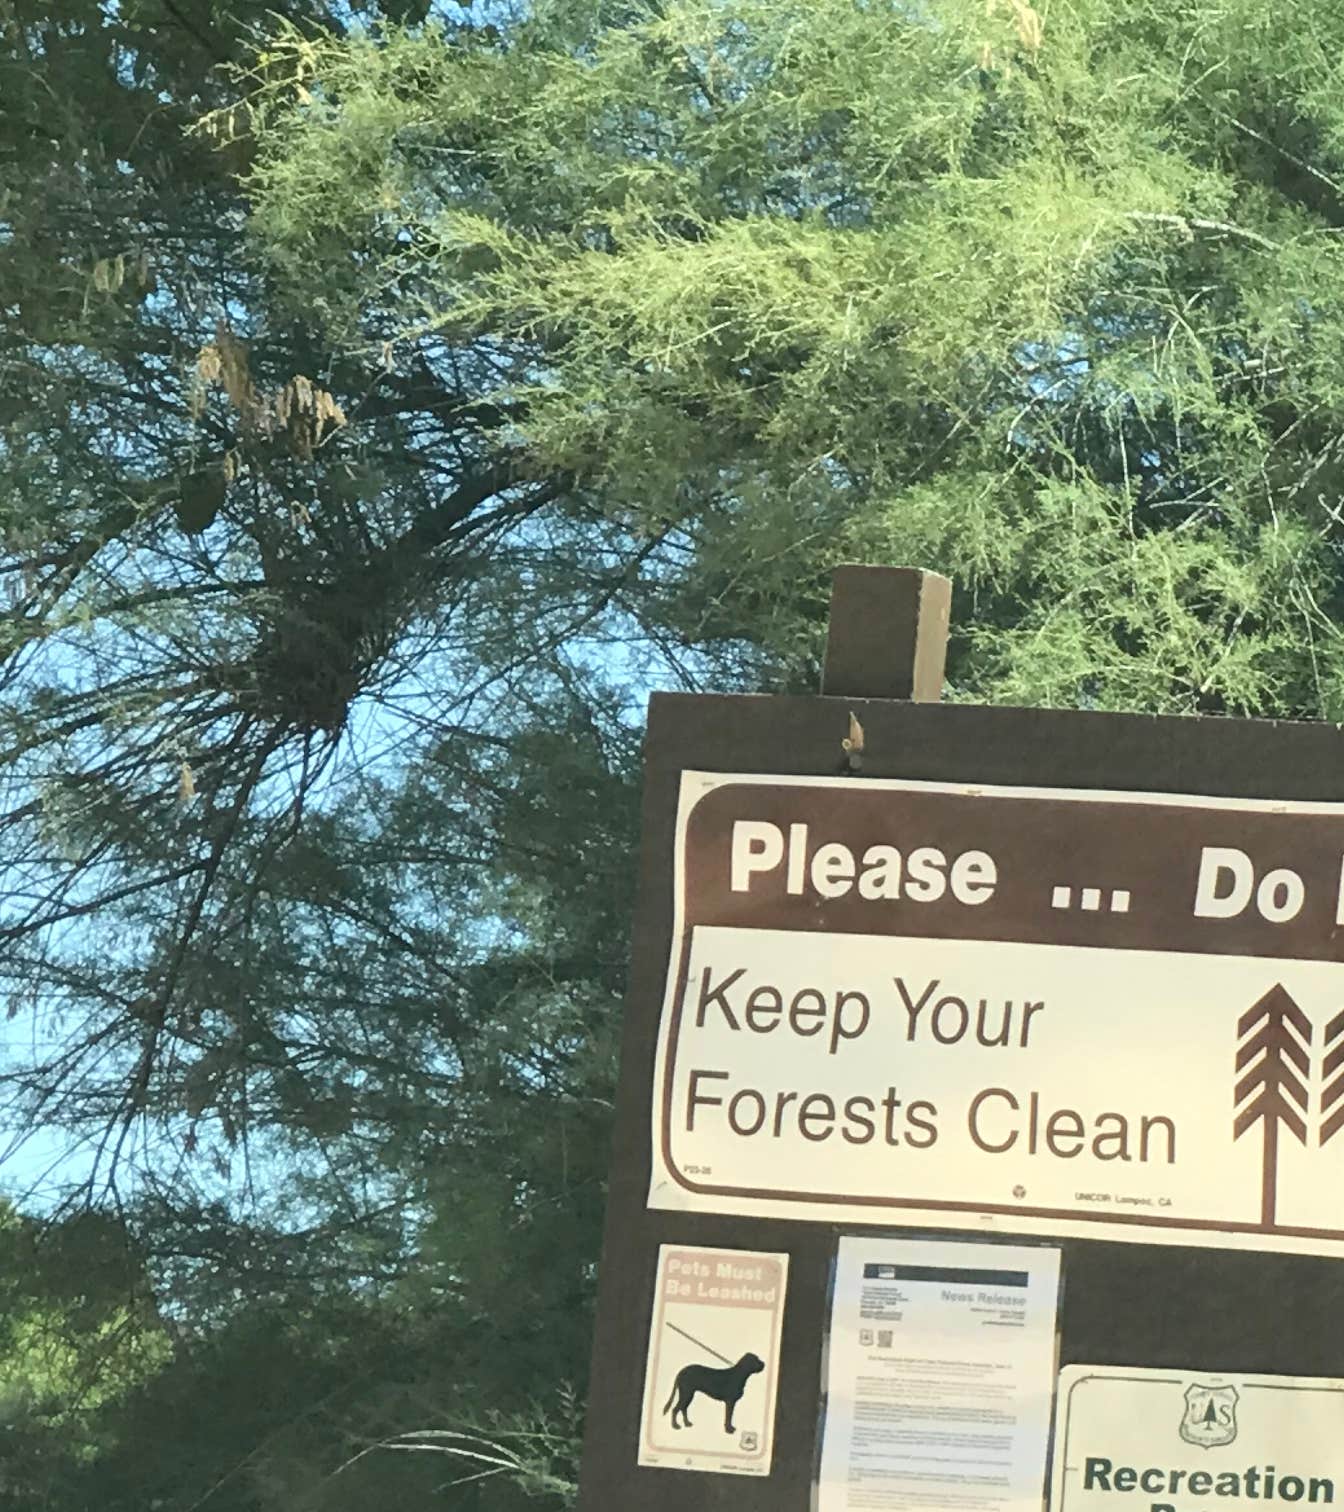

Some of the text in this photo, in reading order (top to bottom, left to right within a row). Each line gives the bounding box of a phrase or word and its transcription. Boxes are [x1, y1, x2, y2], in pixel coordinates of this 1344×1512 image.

[732, 821, 996, 904] Please
[1052, 887, 1130, 912] ...
[1194, 847, 1304, 922] Do
[696, 967, 1044, 1054] Keep Your
[687, 1070, 1175, 1164] Forests Clean
[666, 1279, 776, 1303] Be Leashed
[668, 1259, 762, 1281] Pets Must
[1084, 1458, 1333, 1503] Recreation
